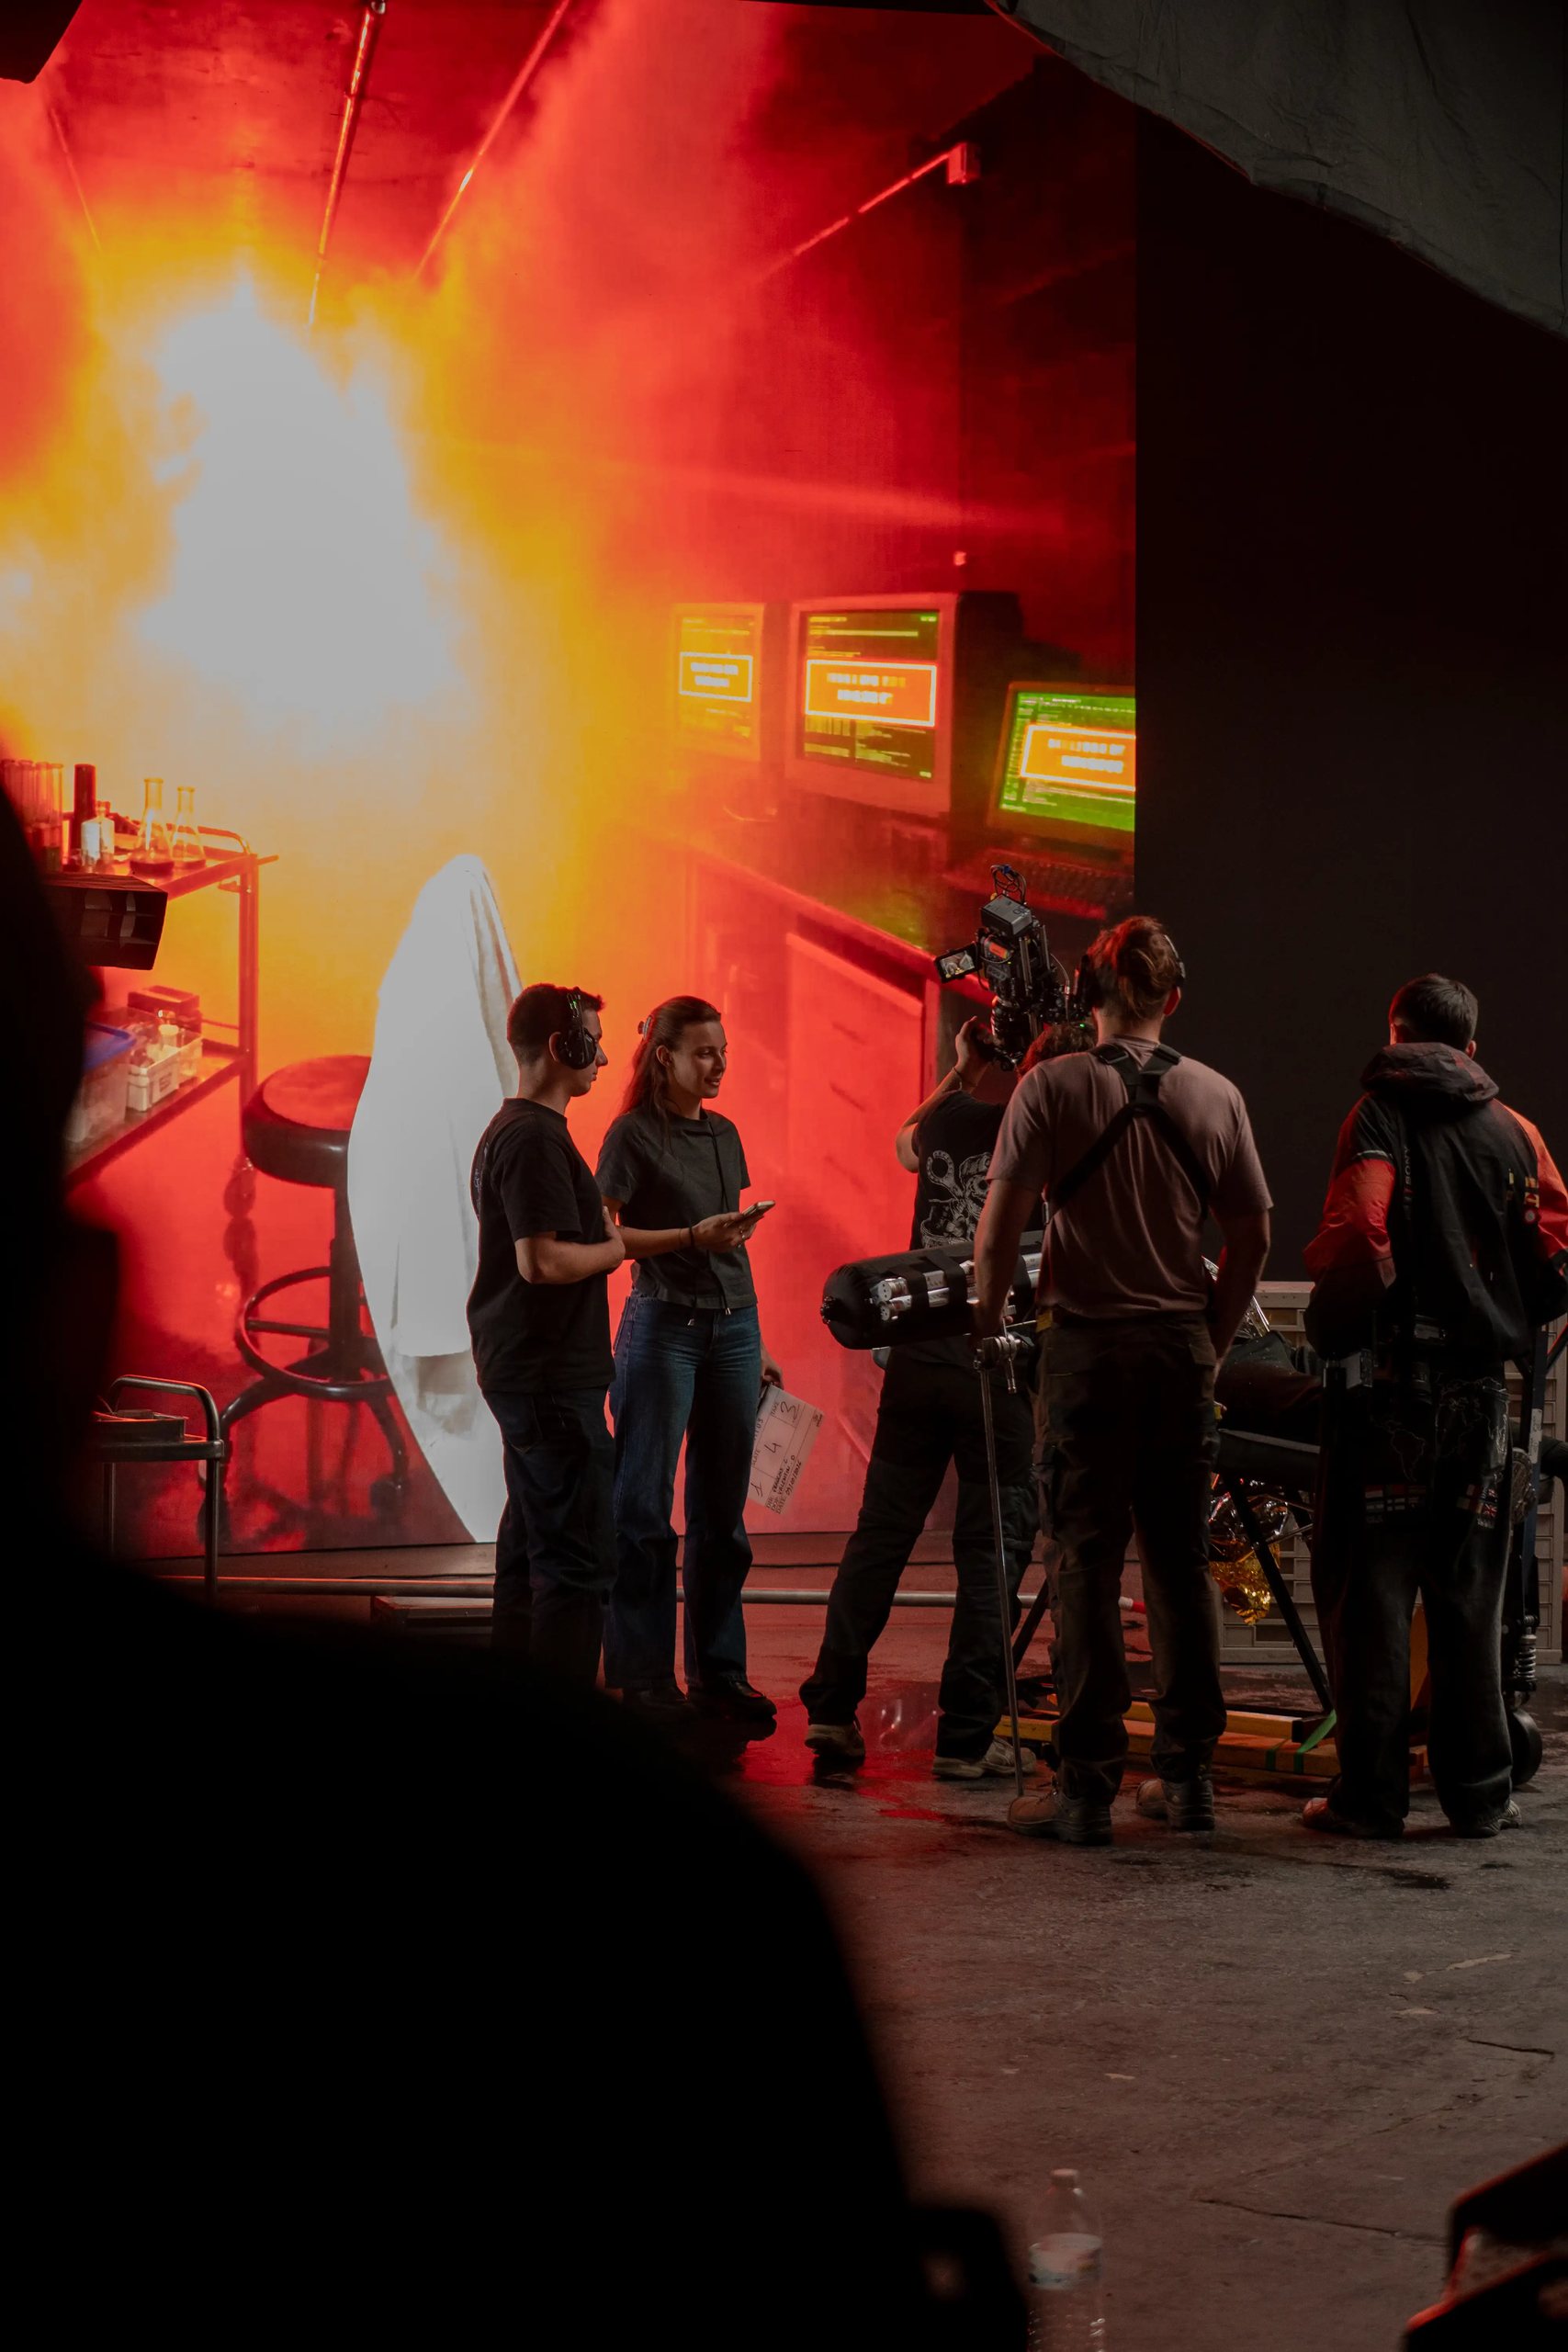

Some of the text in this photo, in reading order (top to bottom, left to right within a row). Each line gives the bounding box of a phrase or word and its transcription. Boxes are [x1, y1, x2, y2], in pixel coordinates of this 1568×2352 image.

[1404, 1146, 1412, 1186] SONY
[780, 1401, 800, 1420] 3
[764, 1442, 783, 1453] 4
